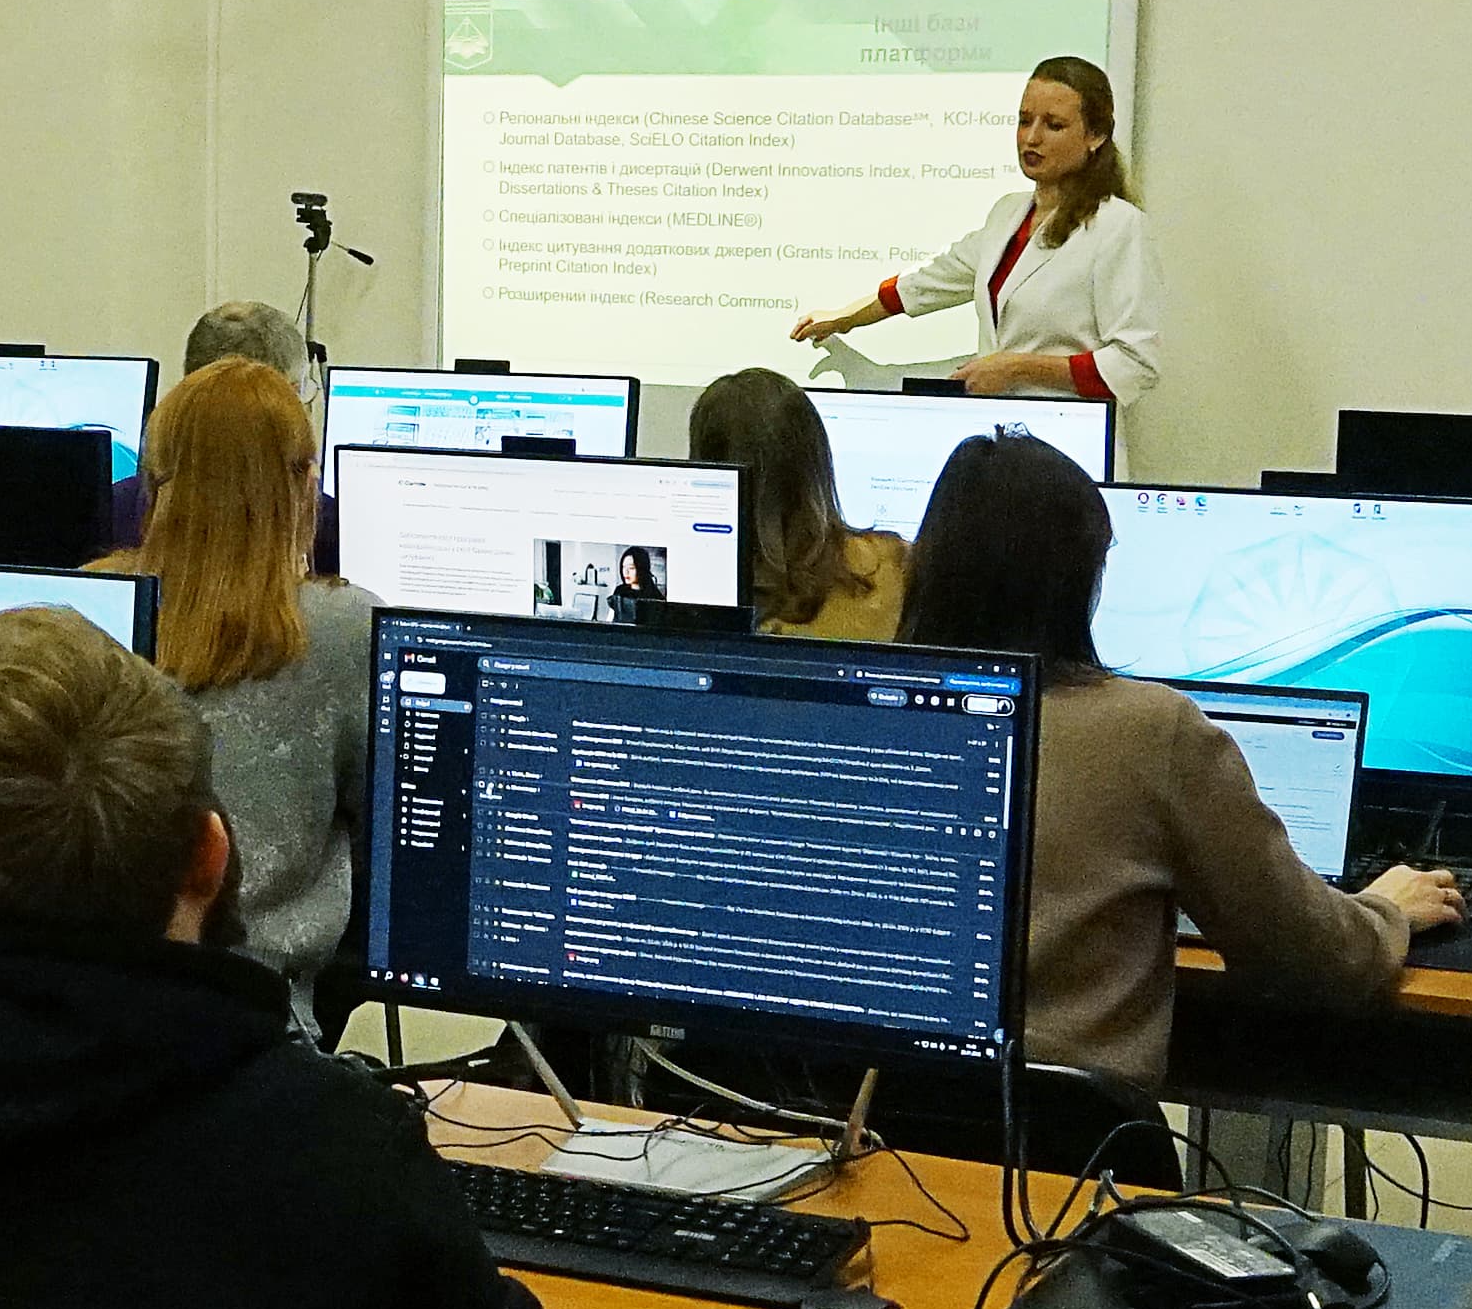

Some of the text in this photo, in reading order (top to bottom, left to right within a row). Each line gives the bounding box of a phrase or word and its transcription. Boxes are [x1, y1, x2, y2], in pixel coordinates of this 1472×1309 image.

[643, 111, 709, 128] (Chinese
[713, 111, 772, 126] Science
[776, 111, 834, 126] Citation
[943, 111, 1017, 127] KCI-Kore
[499, 132, 550, 146] Journal
[554, 132, 625, 148] Database,
[689, 132, 744, 148] Citation
[748, 133, 796, 149] Index)
[705, 162, 773, 179] (Derwent
[777, 163, 864, 178] Innovations
[869, 164, 916, 180] Index,
[920, 164, 996, 180] ProQuest
[499, 181, 588, 196] Dissertations
[607, 181, 658, 197] Theses
[662, 182, 717, 197] Citation
[721, 183, 769, 200] Index)
[776, 243, 834, 261] (Grants
[499, 258, 657, 277] Preprint Citation Index)
[639, 290, 713, 308] (Research
[717, 293, 799, 311] Commons)
